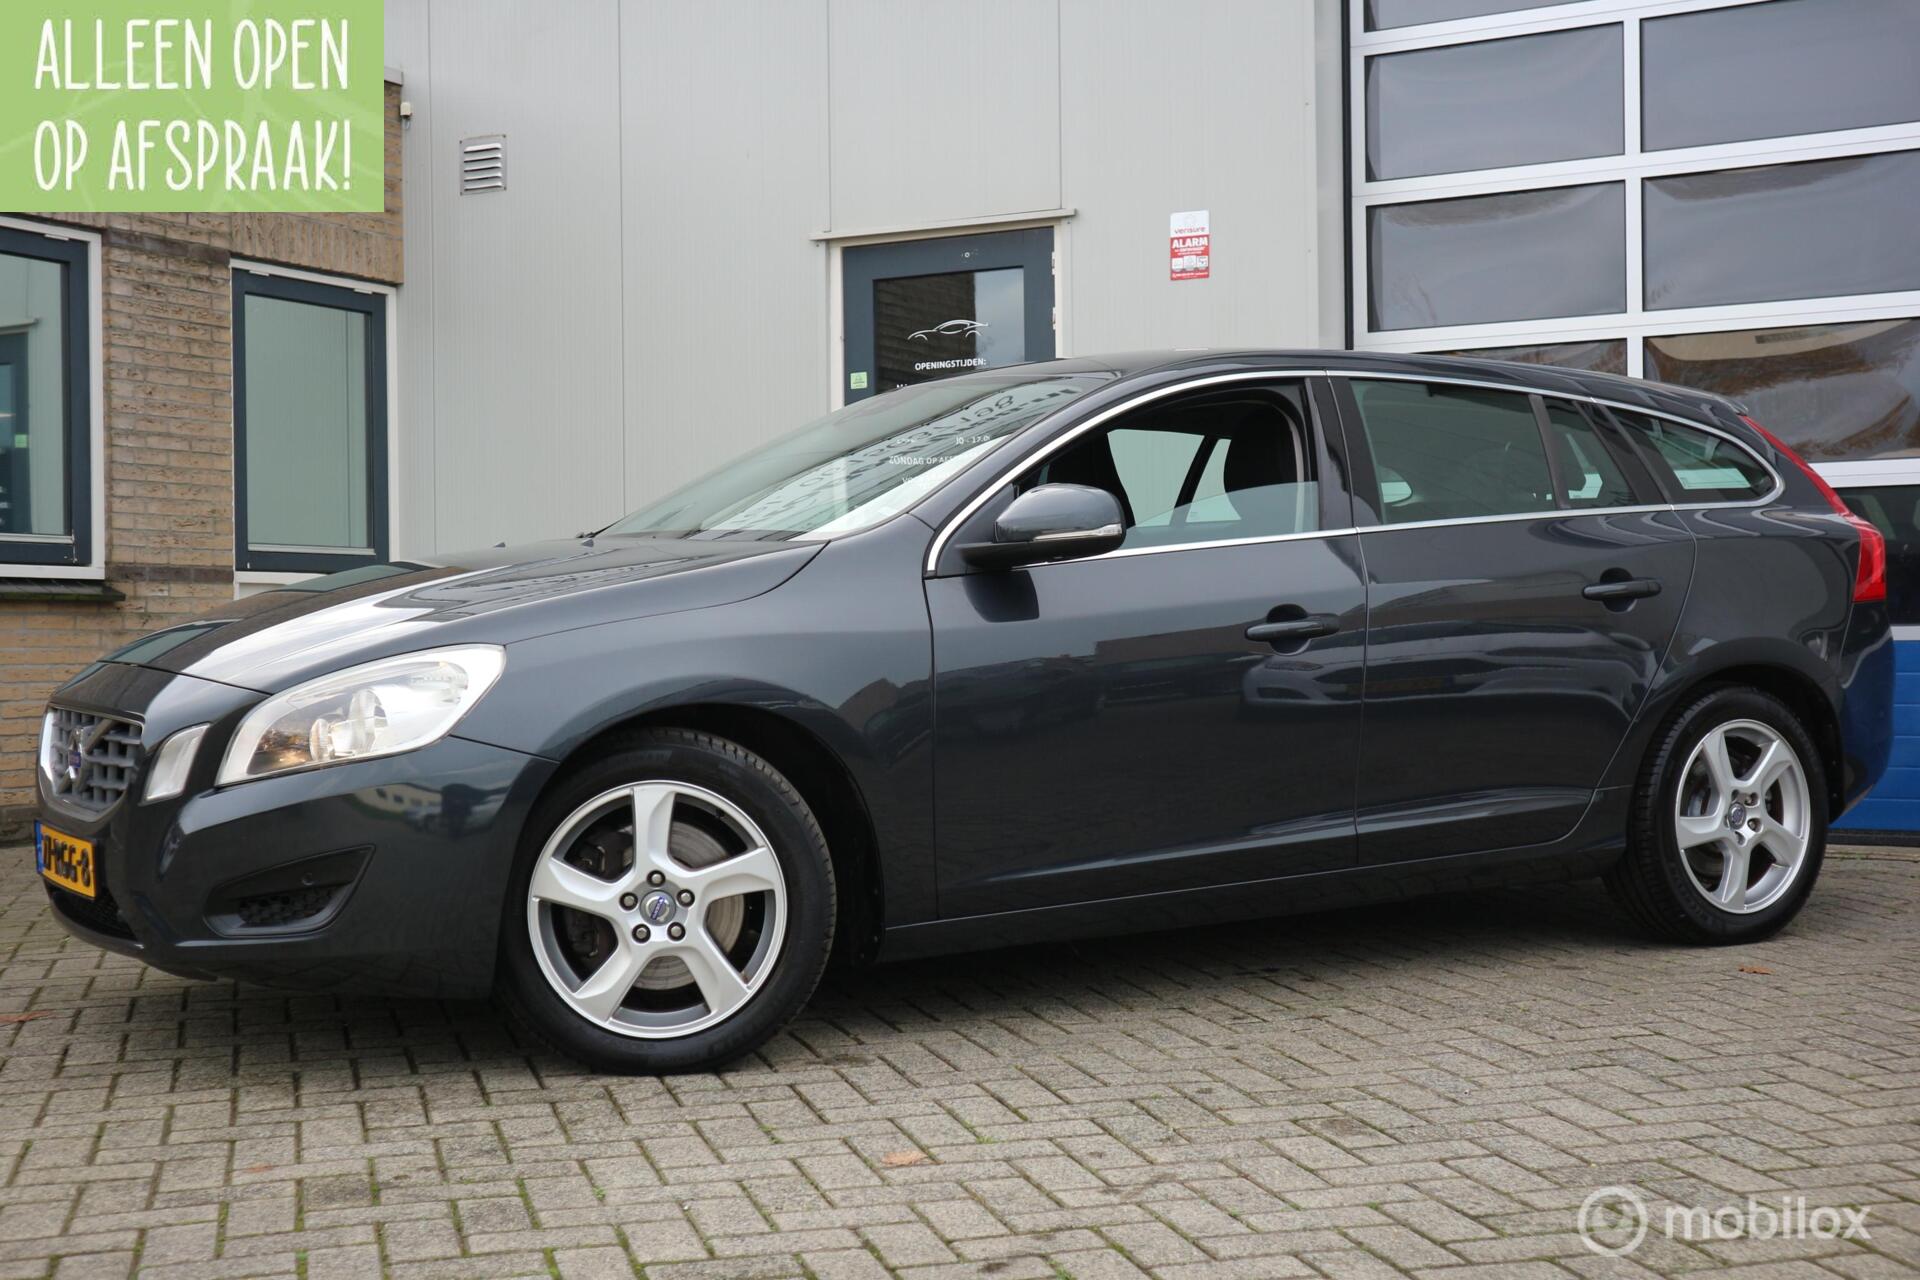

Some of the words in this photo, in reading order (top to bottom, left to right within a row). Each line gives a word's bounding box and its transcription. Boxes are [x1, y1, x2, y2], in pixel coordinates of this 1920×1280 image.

[1172, 237, 1208, 248] ALARM
[914, 358, 987, 371] OPENINGSTIJDEN:
[926, 456, 938, 465] OP
